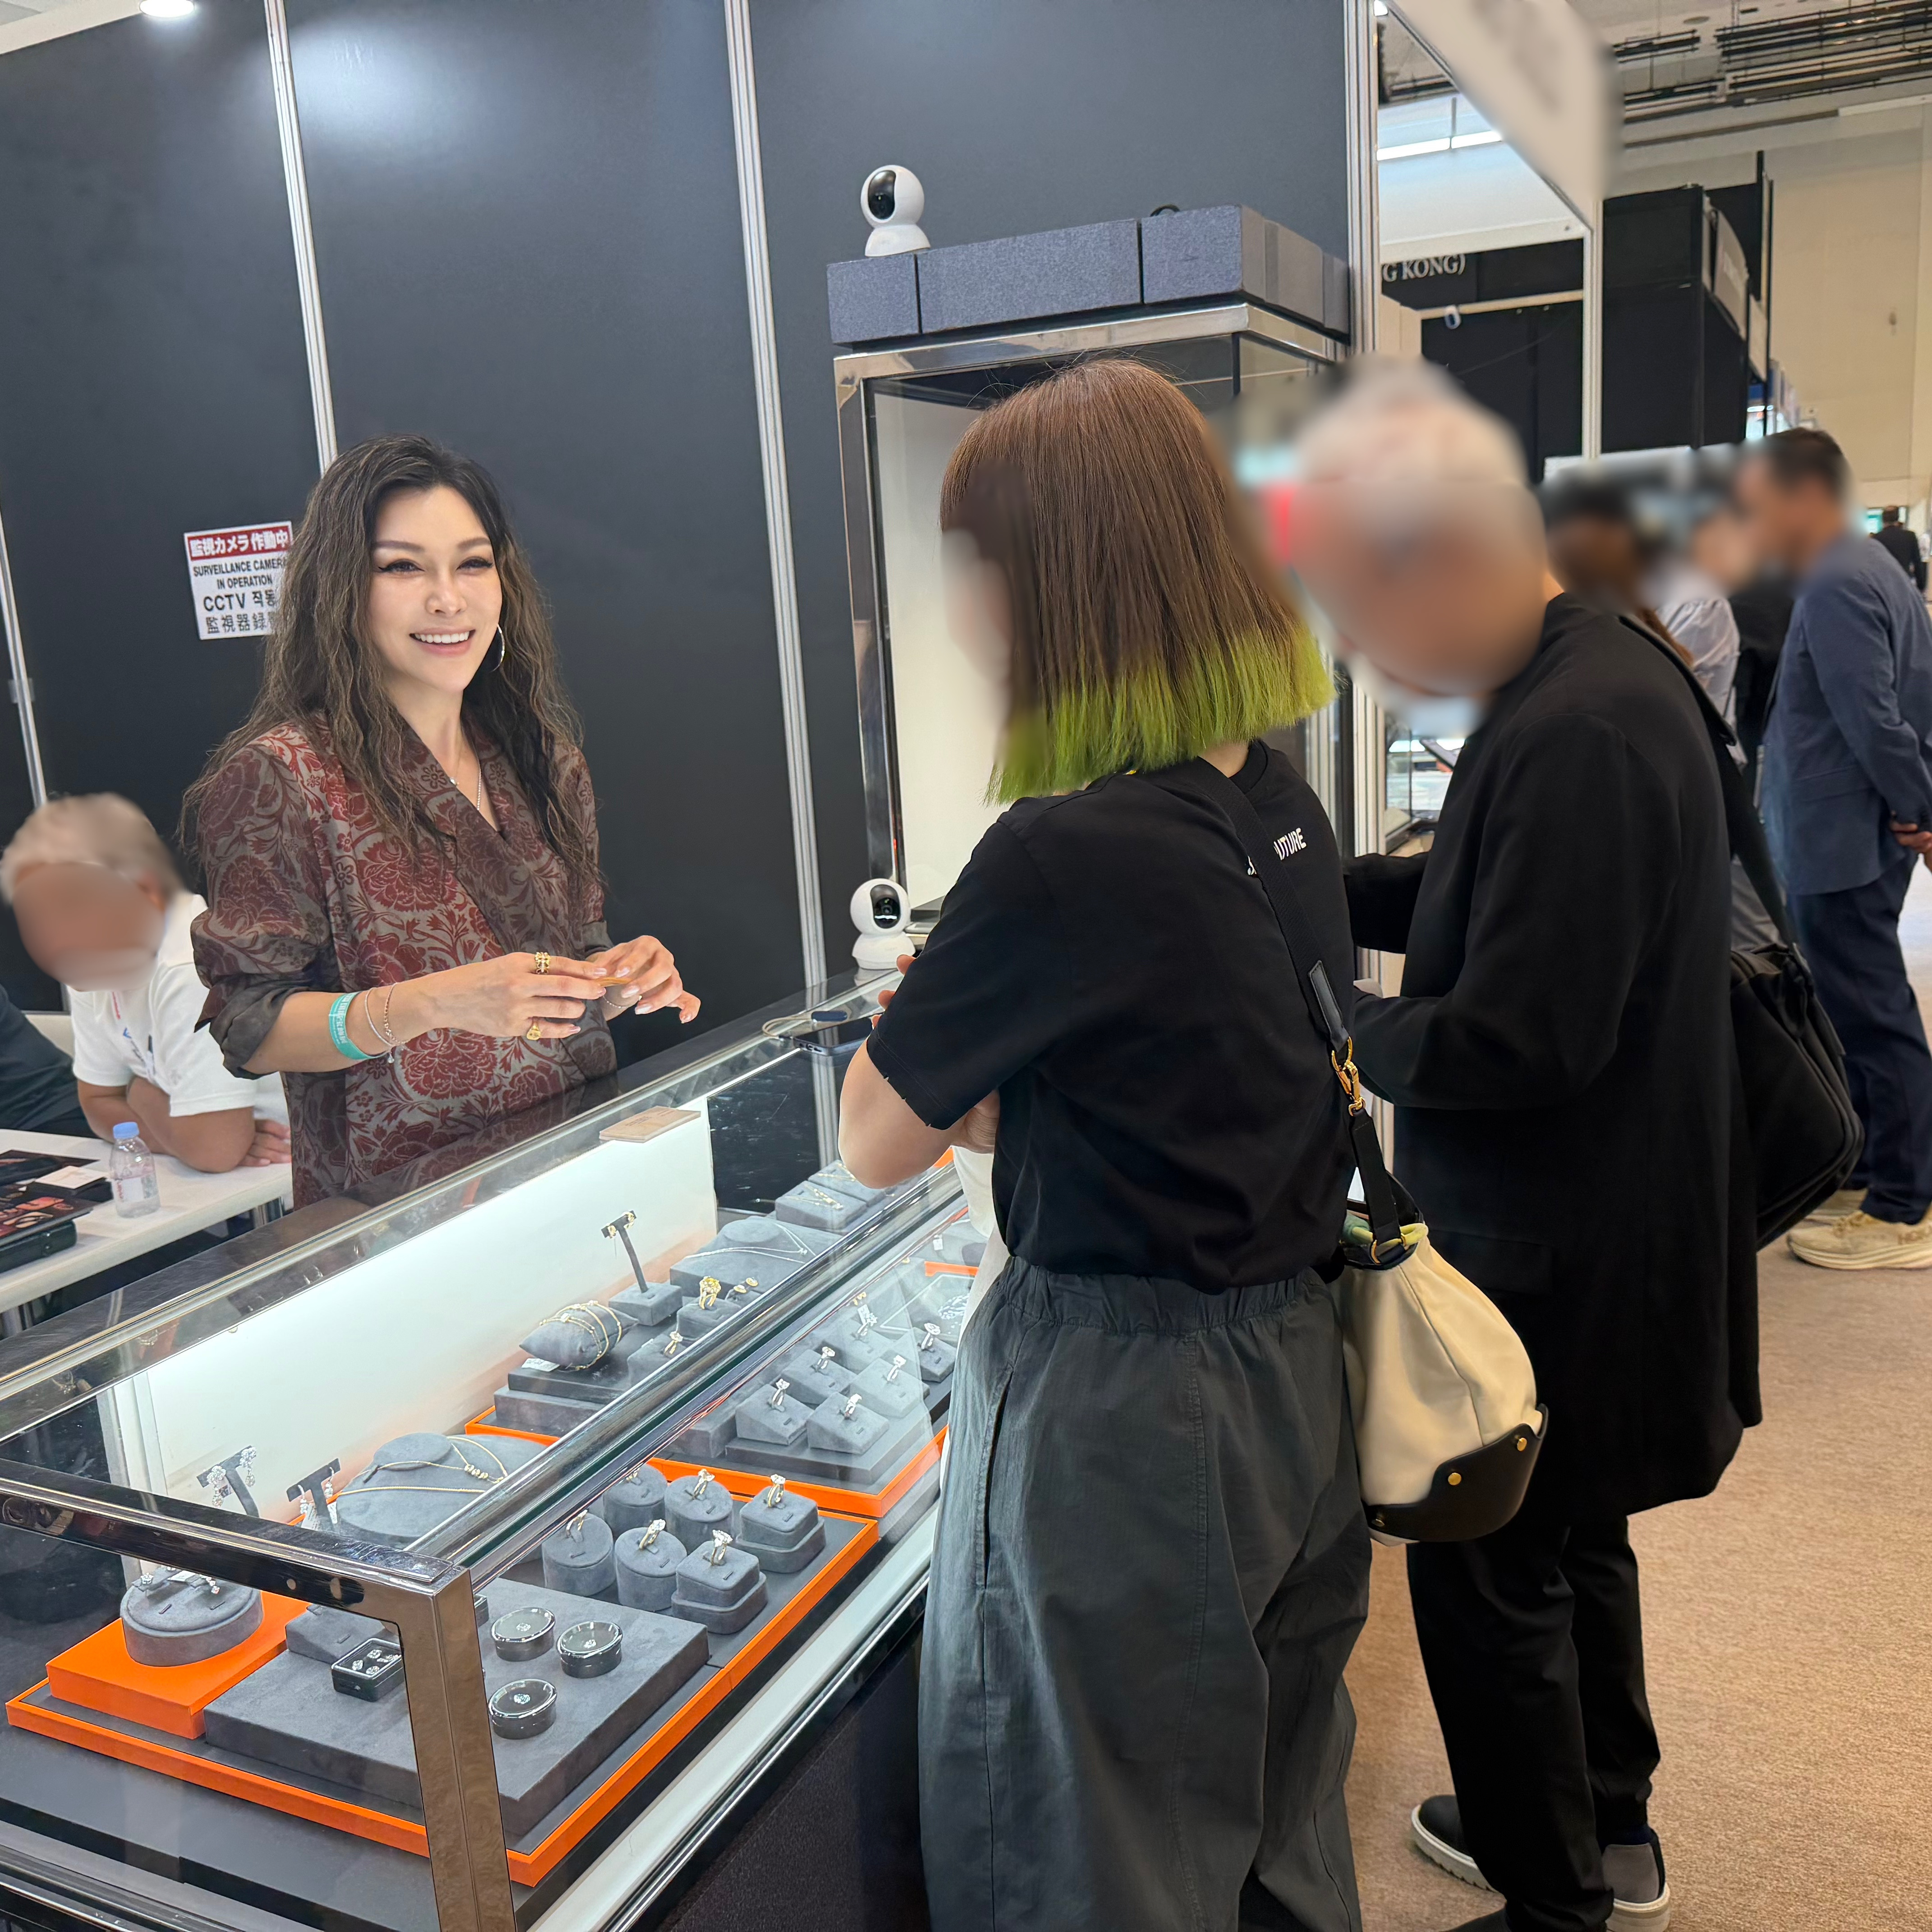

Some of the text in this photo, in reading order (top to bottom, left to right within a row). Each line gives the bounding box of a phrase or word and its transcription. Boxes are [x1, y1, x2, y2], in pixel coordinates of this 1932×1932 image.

[1402, 253, 1465, 280] KONG)
[193, 561, 251, 577] SURVEILLANCE
[217, 575, 273, 589] IN OPERATION
[203, 593, 245, 612] CCTV
[1274, 828, 1307, 860] UTURE
